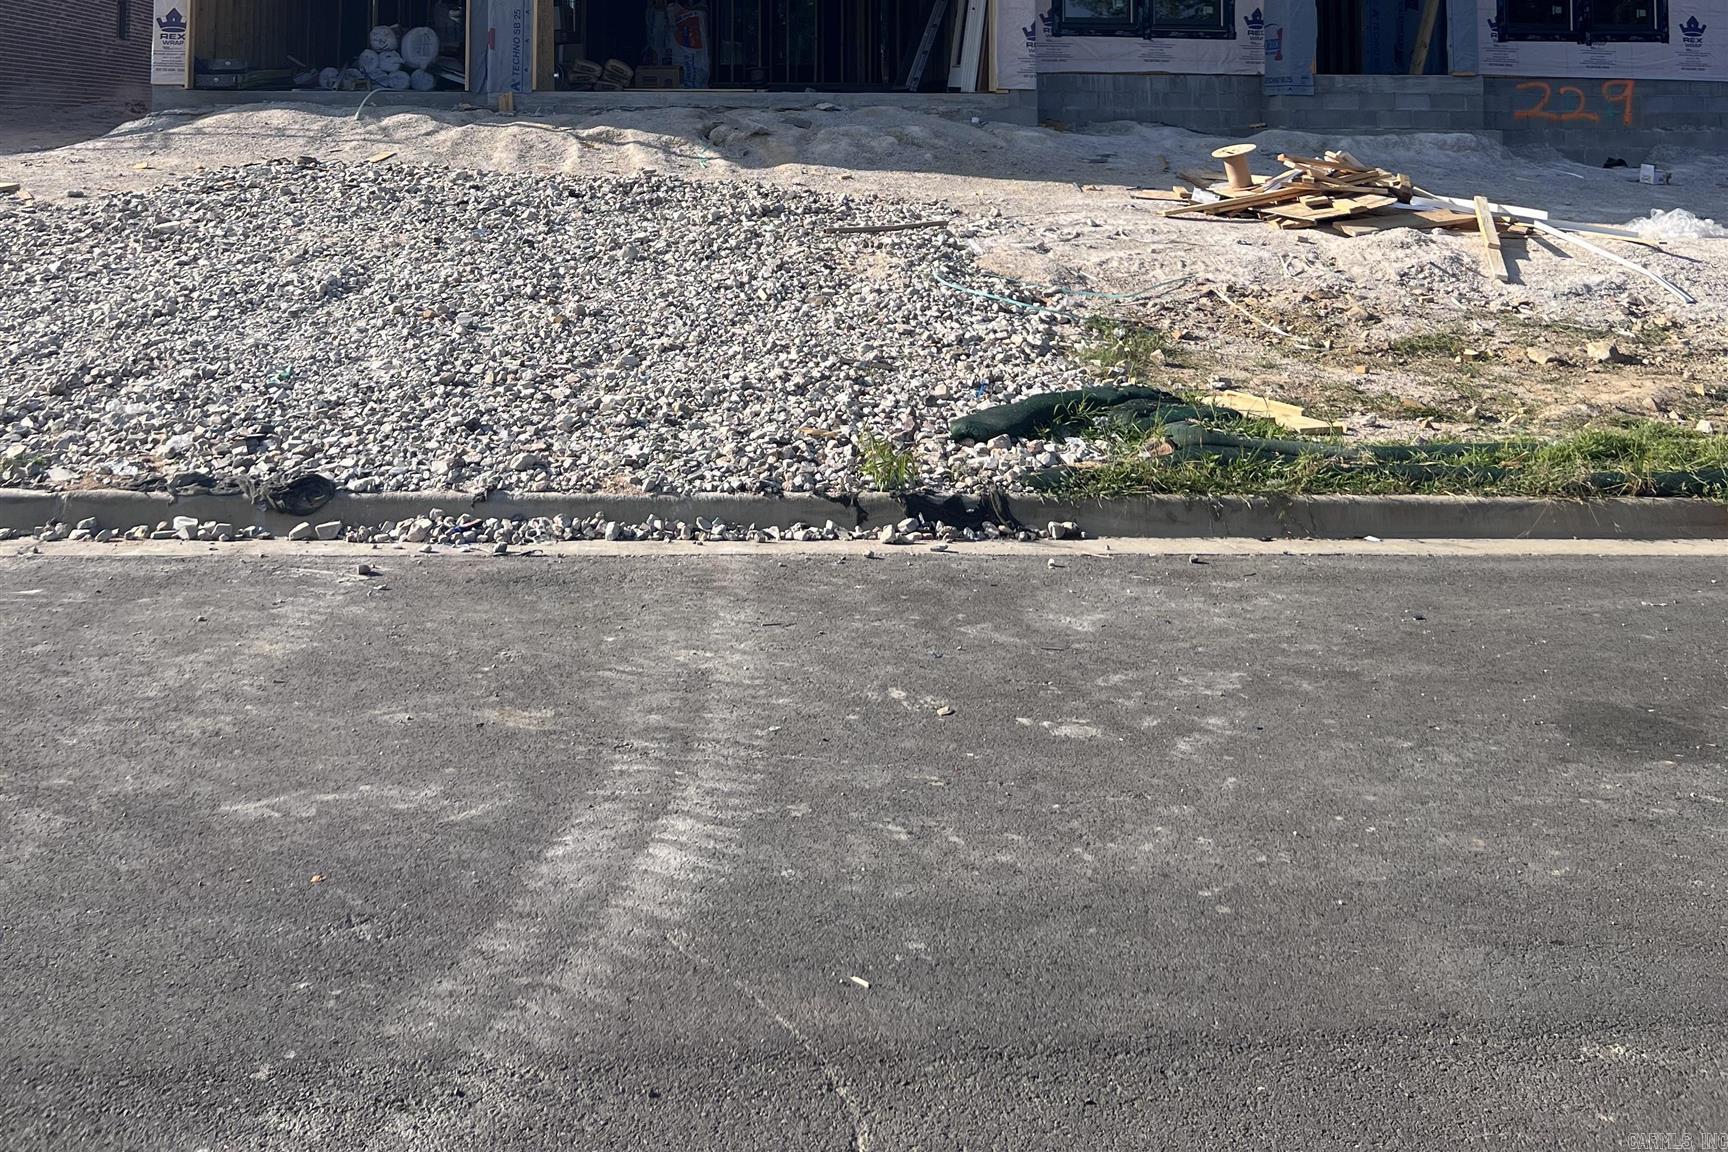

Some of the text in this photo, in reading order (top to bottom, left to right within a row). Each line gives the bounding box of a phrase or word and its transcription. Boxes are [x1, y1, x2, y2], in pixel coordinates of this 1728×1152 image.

[513, 8, 521, 21] 25
[513, 22, 521, 35] SB
[511, 35, 521, 79] TECHNO
[1513, 79, 1636, 127] 229
